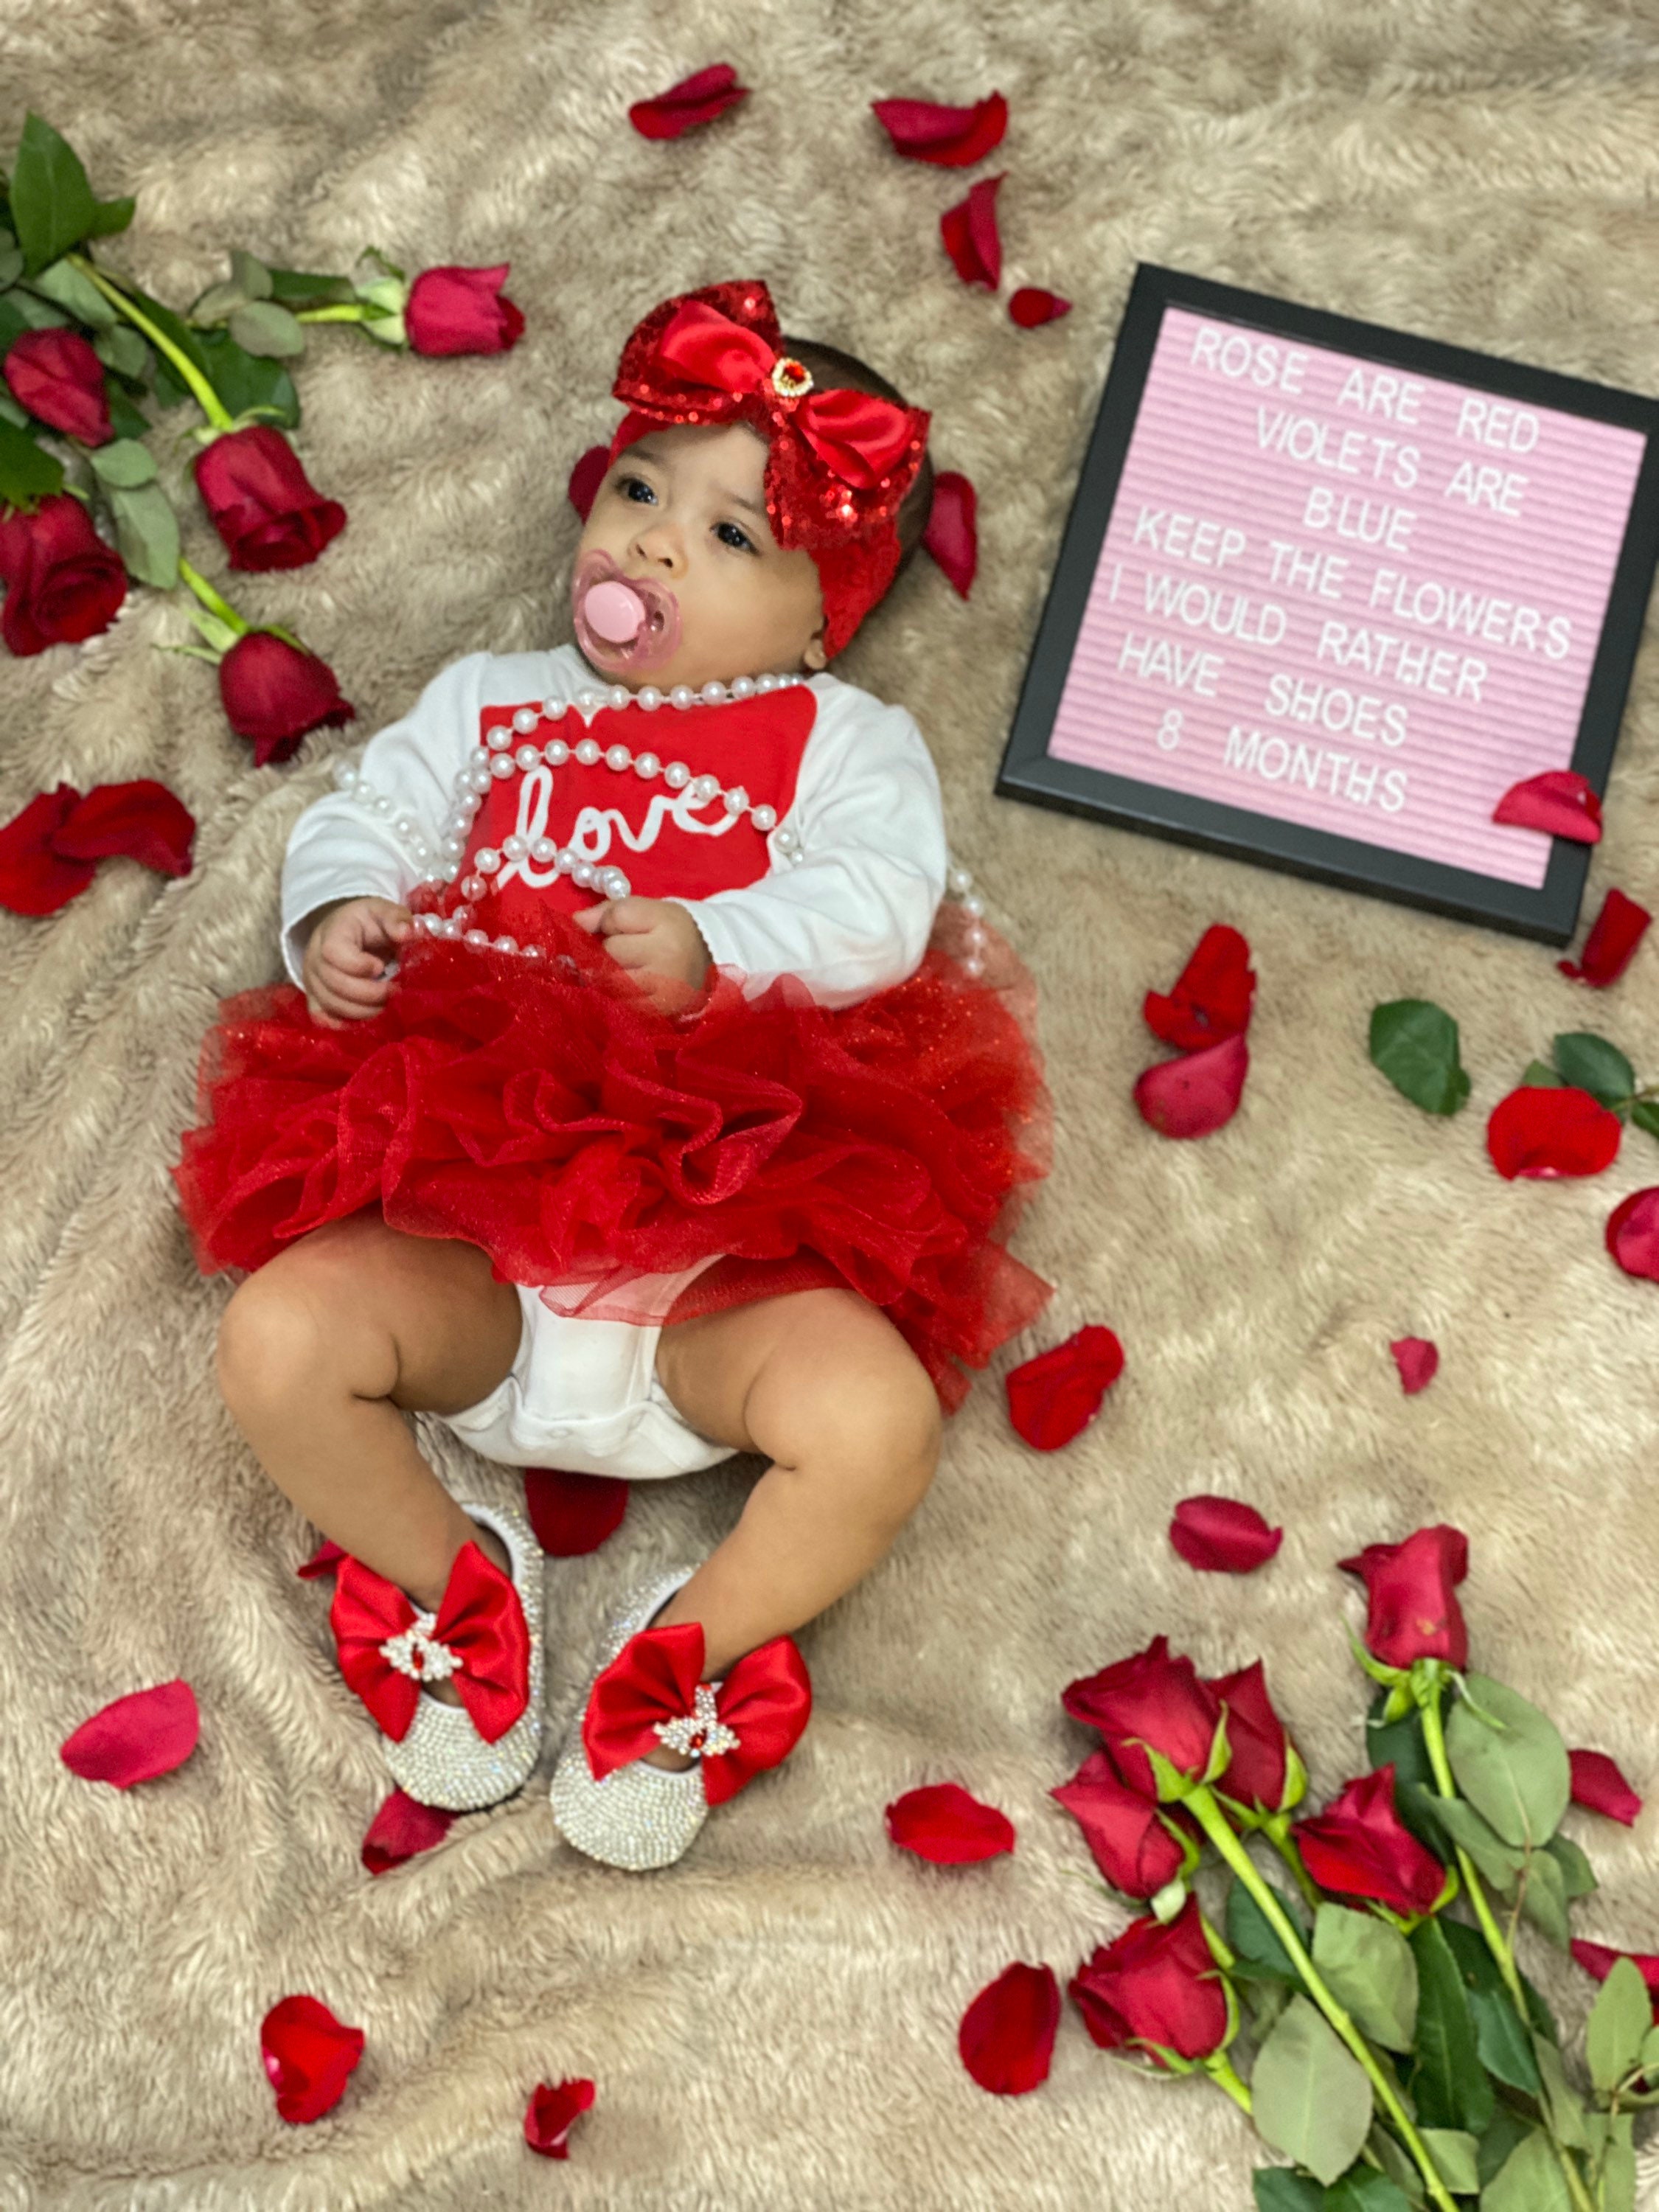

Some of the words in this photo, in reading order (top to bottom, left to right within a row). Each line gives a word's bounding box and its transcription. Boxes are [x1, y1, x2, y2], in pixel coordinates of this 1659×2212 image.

[1192, 327, 1308, 394] ROSE
[1338, 369, 1426, 425] ARE
[1457, 397, 1540, 453] RED
[1256, 407, 1421, 487] VIOLETS
[1444, 462, 1529, 516] ARE
[1303, 487, 1418, 553] BLUE
[1108, 565, 1124, 604] I
[1145, 573, 1287, 646] WOULD
[1318, 622, 1489, 702] RATHER
[1133, 507, 1246, 568] KEEP
[1270, 543, 1349, 598] THE
[1369, 571, 1573, 660] FLOWERS
[1117, 633, 1225, 697] HAVE
[1265, 675, 1409, 748] SHOES
[1157, 710, 1183, 750] 8
[1224, 726, 1409, 813] MONTHS
[493, 765, 748, 889] love
